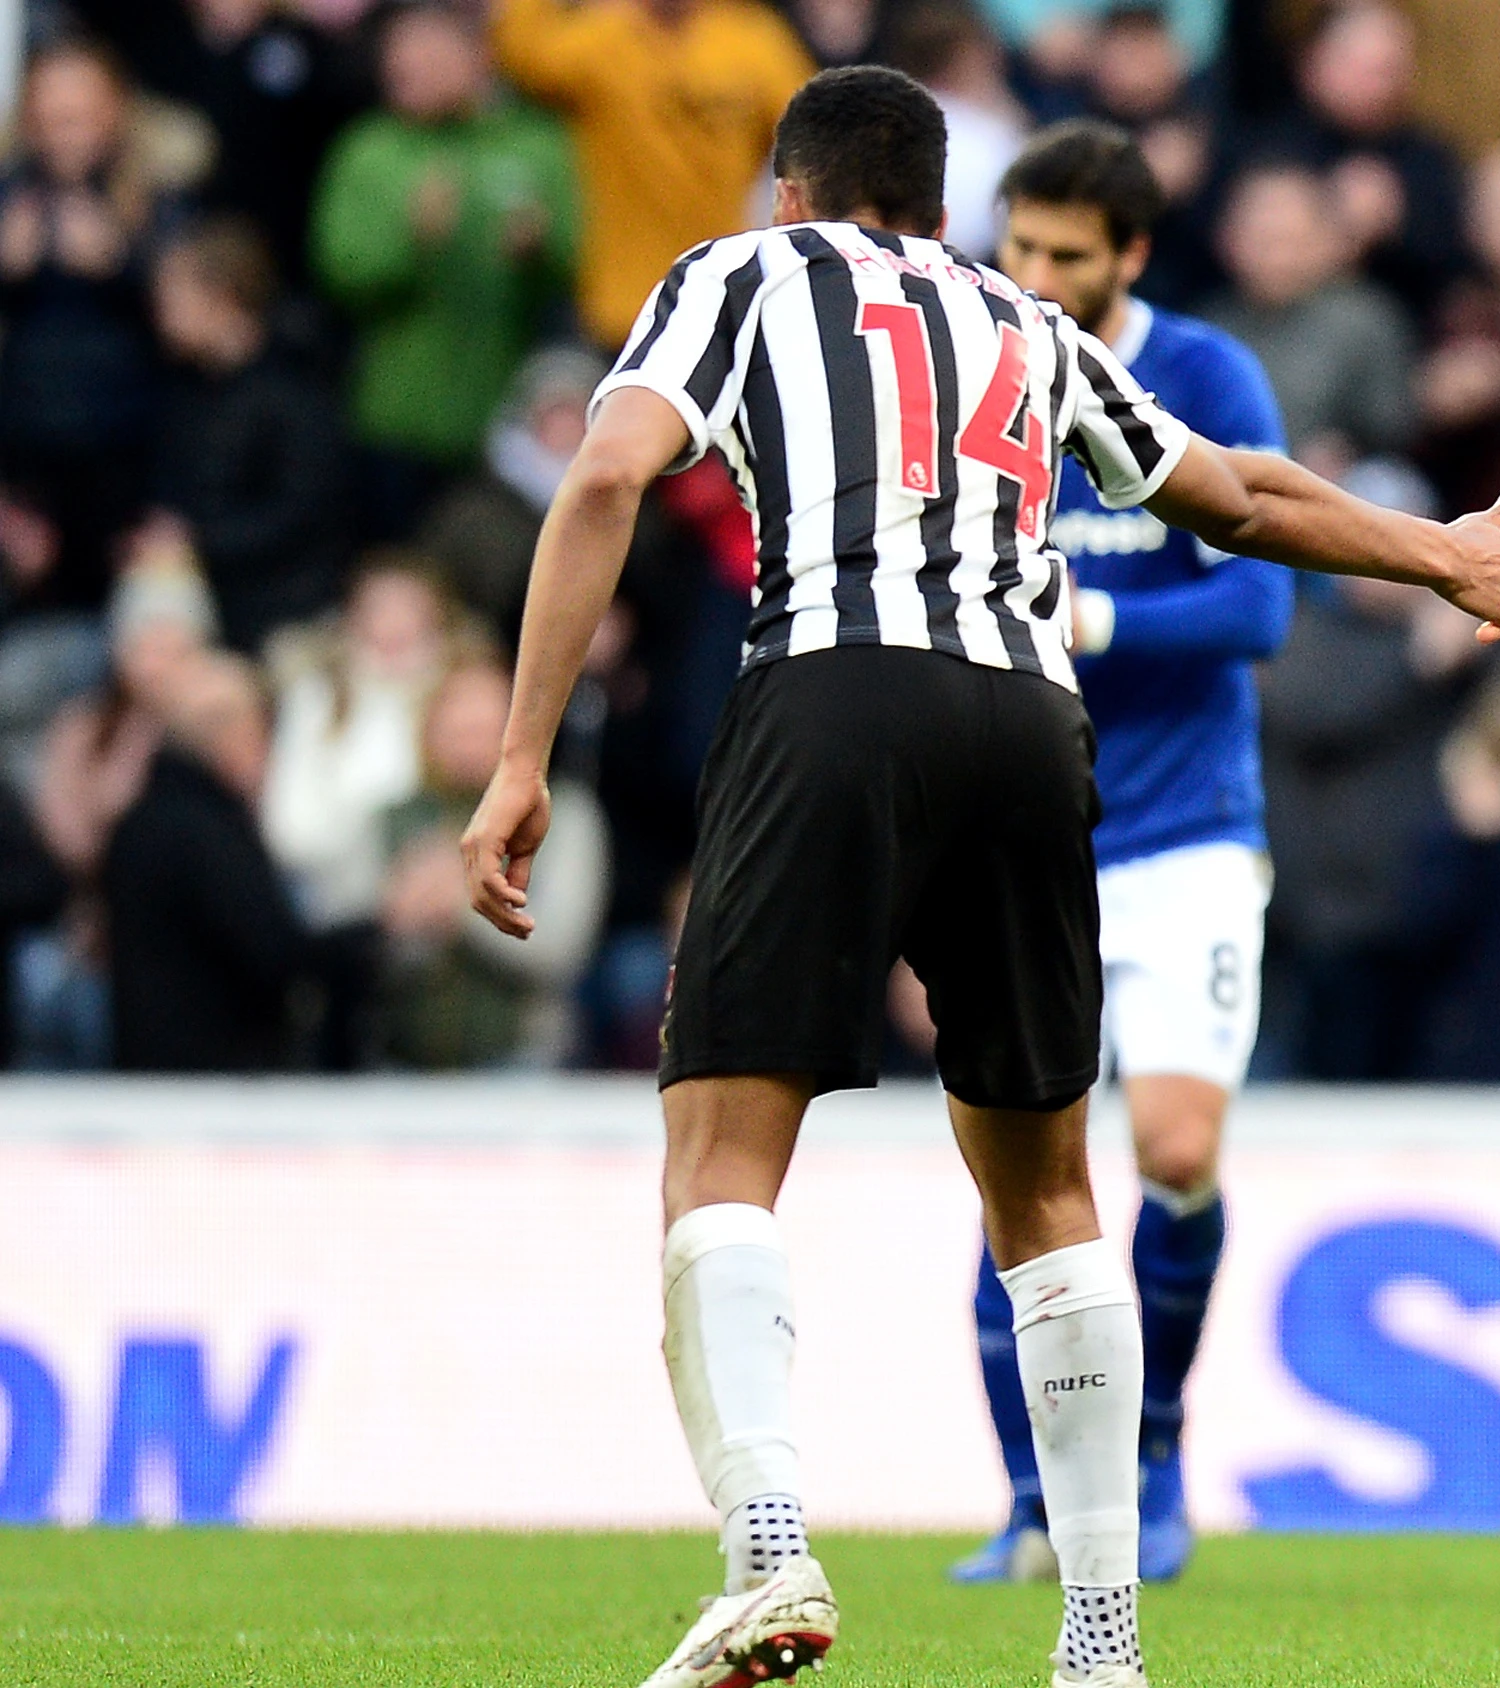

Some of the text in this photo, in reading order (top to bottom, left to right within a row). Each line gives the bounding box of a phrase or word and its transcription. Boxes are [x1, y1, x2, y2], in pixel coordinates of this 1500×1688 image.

[838, 246, 1044, 325] HAYDE
[855, 301, 1054, 541] 14
[1209, 941, 1242, 1012] 8
